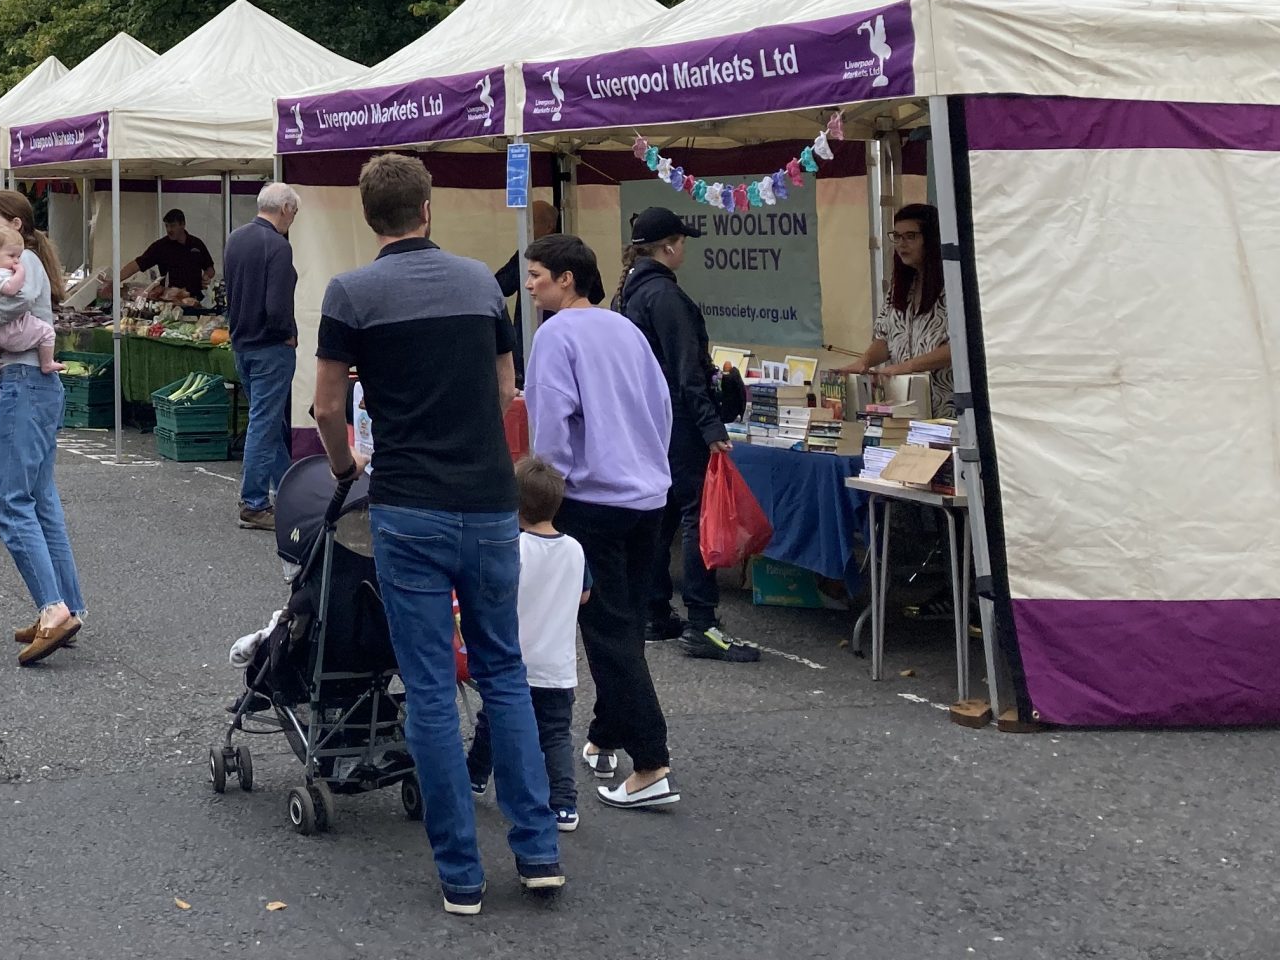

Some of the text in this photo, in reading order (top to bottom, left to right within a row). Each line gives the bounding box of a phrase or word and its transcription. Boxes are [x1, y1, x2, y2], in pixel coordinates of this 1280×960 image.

[586, 43, 799, 101] Liverpool Markets Ltd
[844, 57, 875, 70] Liverpool
[316, 93, 444, 132] Liverpool Markets Ltd
[29, 132, 54, 152] Liverpool
[52, 131, 76, 147] Markets
[74, 128, 85, 145] Ltd
[713, 212, 808, 236] WOOLTON
[704, 248, 782, 271] SOCIETY
